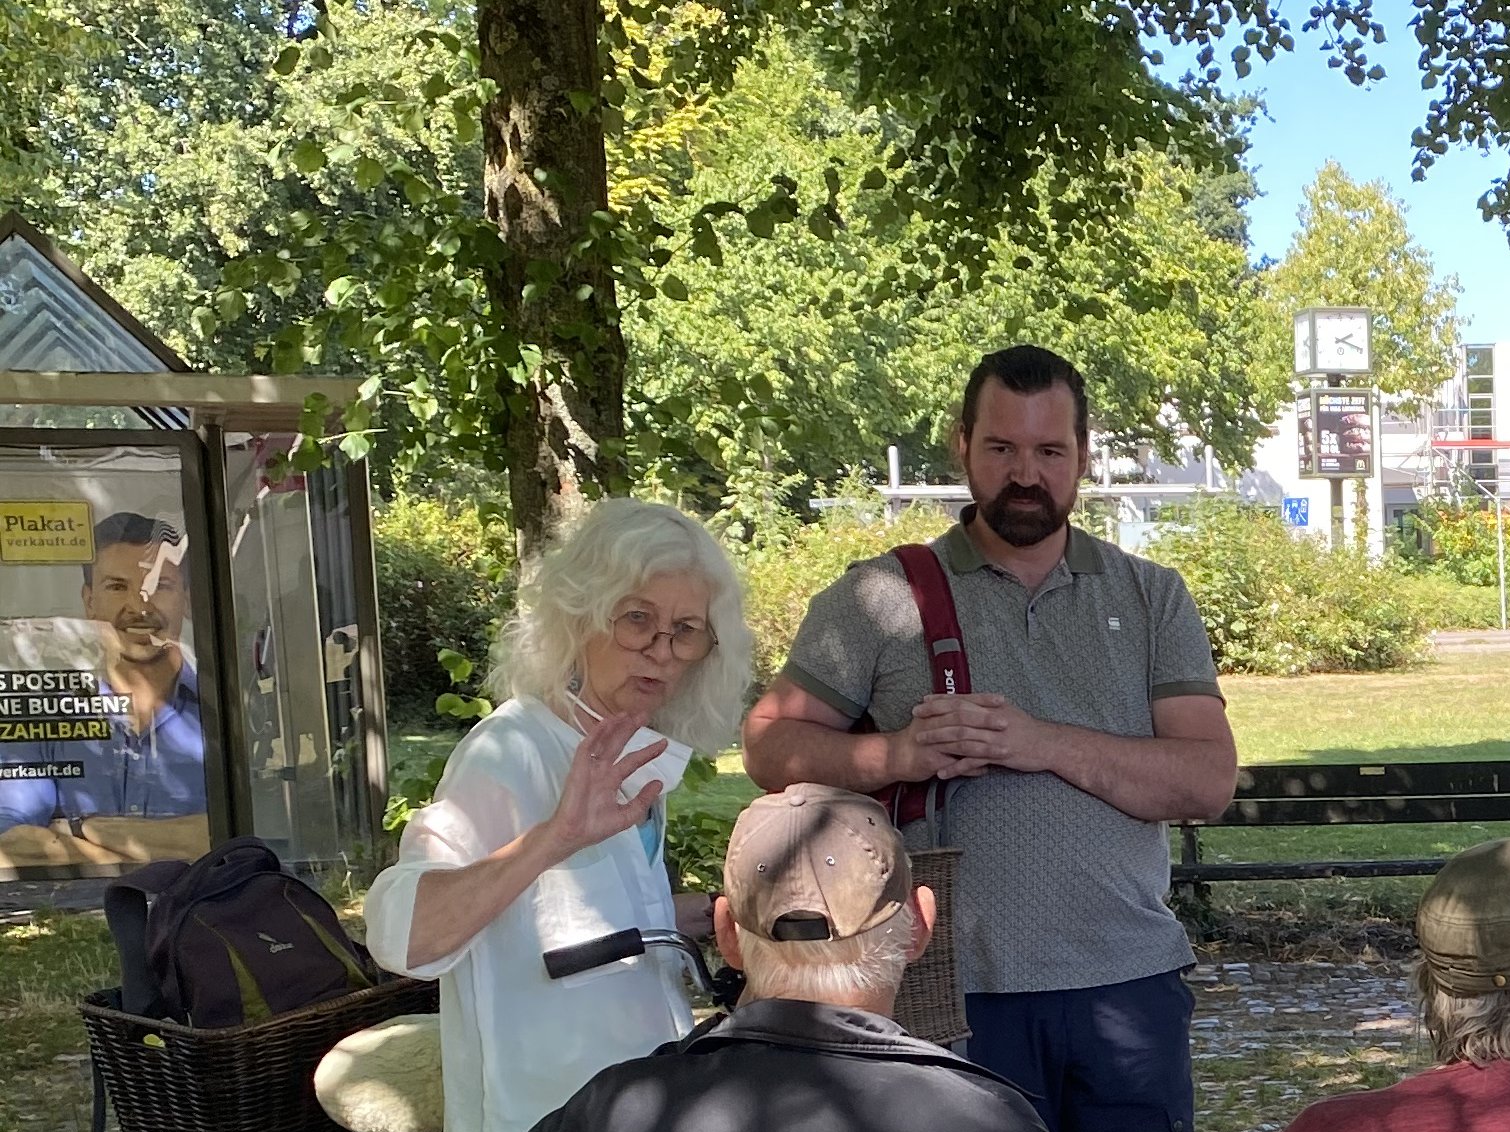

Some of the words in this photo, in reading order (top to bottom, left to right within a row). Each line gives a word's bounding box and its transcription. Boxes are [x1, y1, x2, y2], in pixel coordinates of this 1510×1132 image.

[4, 515, 84, 532] Plakat-
[6, 537, 87, 546] verkauft.de
[12, 672, 95, 691] POSTER
[29, 696, 130, 715] BUCHEN?
[0, 720, 109, 740] ZAHLBAR!
